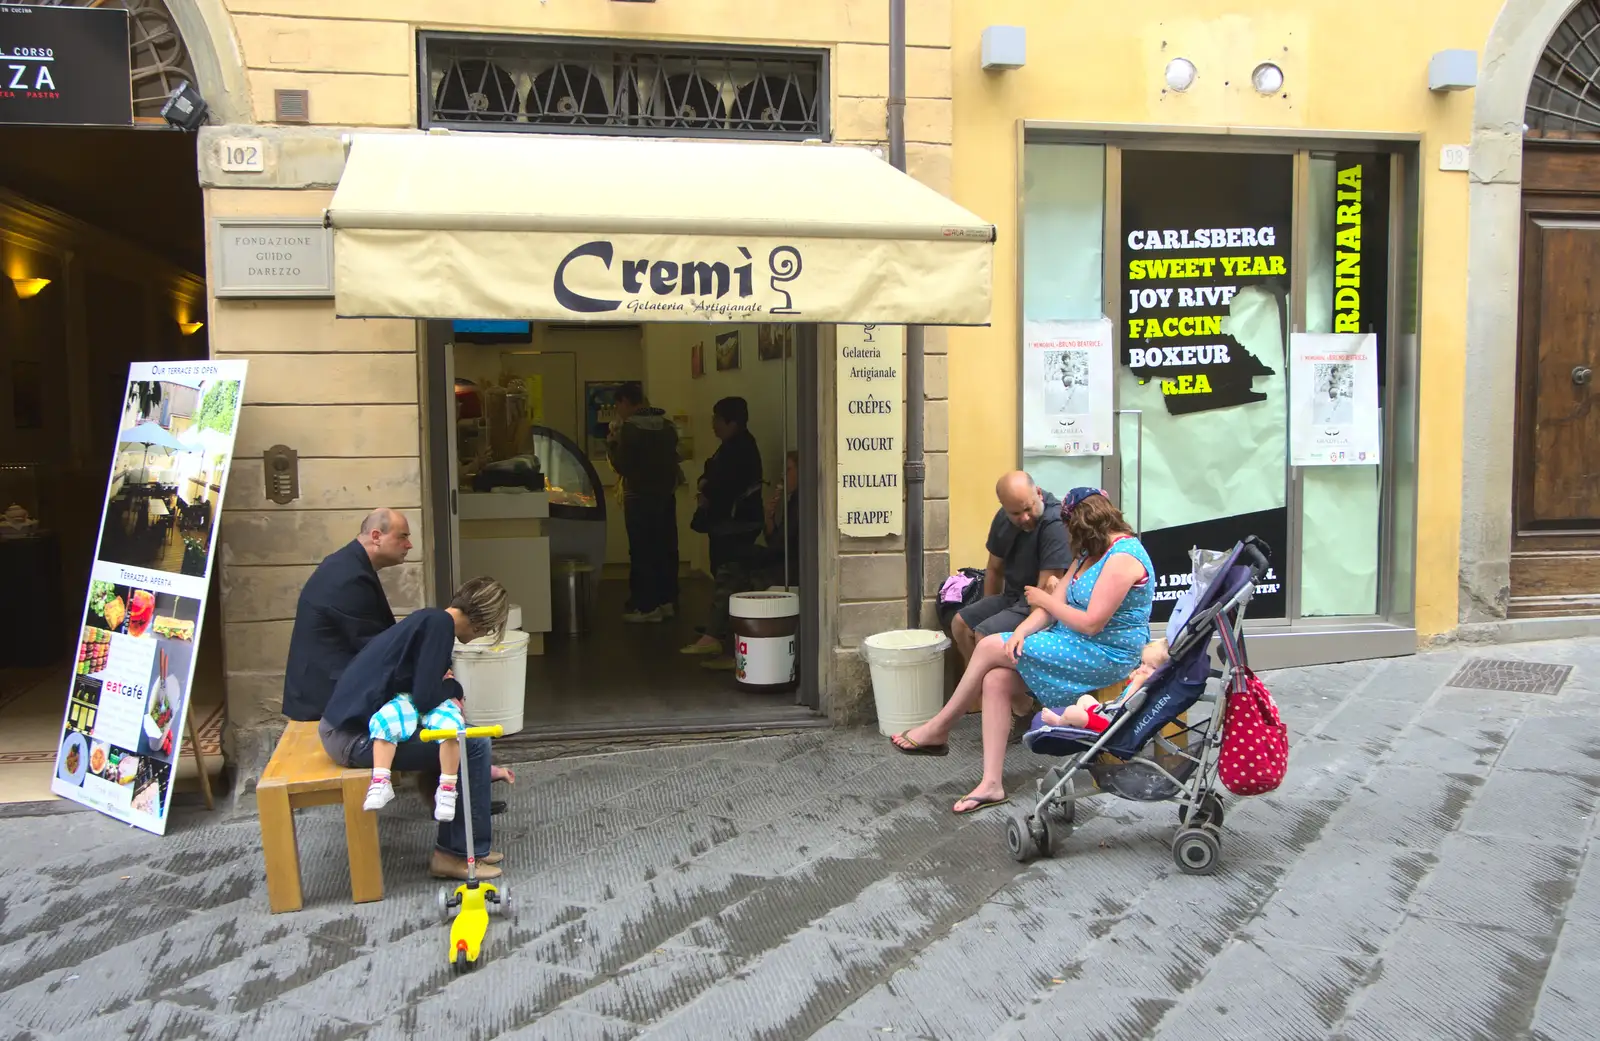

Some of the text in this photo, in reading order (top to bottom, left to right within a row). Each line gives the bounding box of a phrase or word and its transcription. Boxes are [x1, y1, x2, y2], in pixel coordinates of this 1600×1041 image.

[14, 47, 54, 57] CORSO
[0, 64, 56, 90] ZA
[226, 146, 258, 165] 102
[235, 237, 311, 246] FONDAZIONE
[1128, 227, 1276, 250] CARLSBERG
[256, 252, 292, 261] GUIDO
[553, 240, 753, 312] Cremì
[1129, 256, 1287, 280] SWEET YEAR
[626, 300, 763, 314] Gelateria Artigianale
[1129, 288, 1174, 314] JOY
[842, 346, 881, 358] Gelateria
[1129, 344, 1231, 368] BOXEUR
[850, 366, 896, 382] Artigianale
[848, 394, 892, 414] CRÊPES
[846, 437, 894, 451] YOGURT
[842, 474, 897, 488] FRULLATI
[846, 510, 892, 524] FRAPPE'
[1133, 694, 1172, 736] MACLAREN
